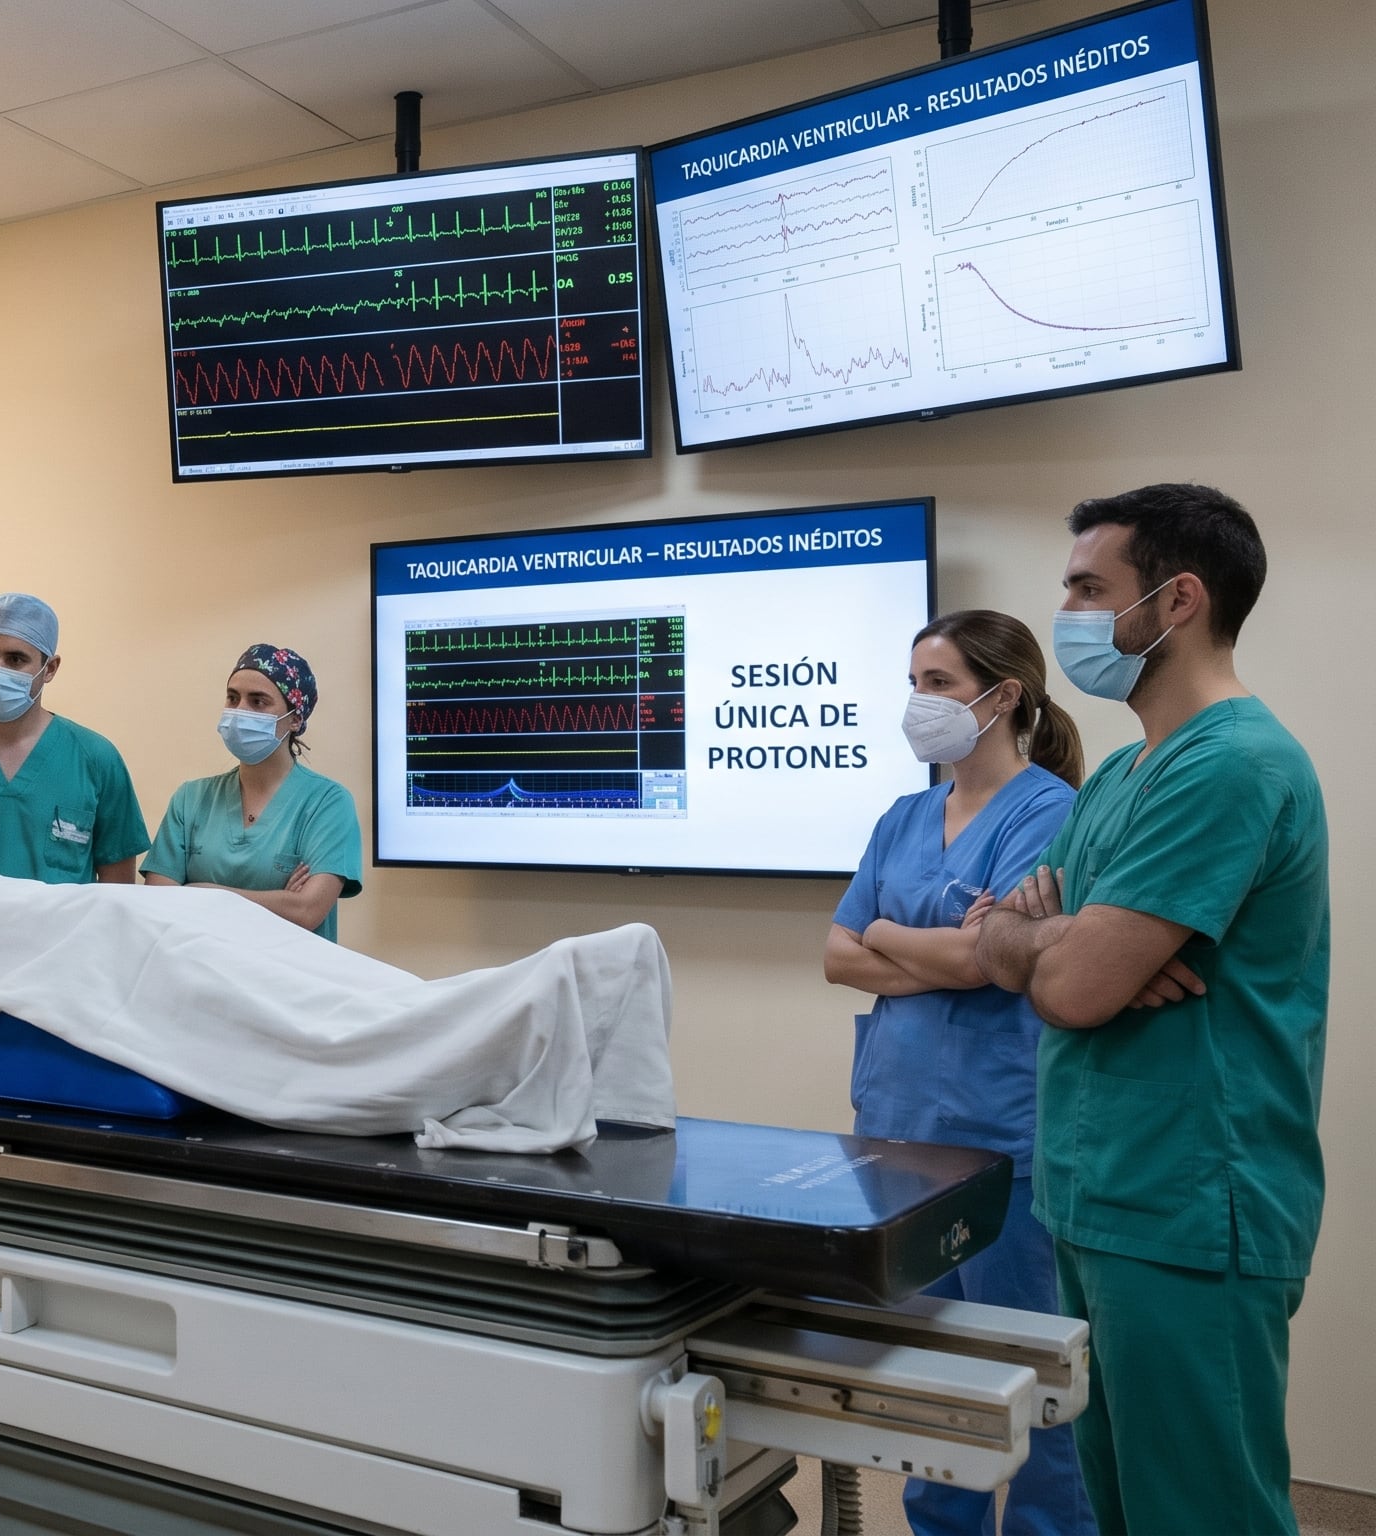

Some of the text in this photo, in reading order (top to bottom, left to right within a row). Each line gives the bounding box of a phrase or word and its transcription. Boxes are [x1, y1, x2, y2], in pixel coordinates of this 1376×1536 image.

[681, 137, 789, 180] TAQUICARDIA
[791, 103, 910, 150] VENTRICULAR
[927, 65, 1048, 114] RESULTADOS
[1053, 35, 1150, 79] INÉDITOS
[407, 556, 518, 579] TAQUICARDIA
[522, 546, 643, 571] VENTRICULAR
[664, 536, 783, 561] RESULTADOS
[789, 527, 883, 552] INÉDITOS
[731, 655, 837, 689] SESIÓN
[715, 699, 858, 730] ÚNICA DE
[708, 744, 868, 770] PROTONES
